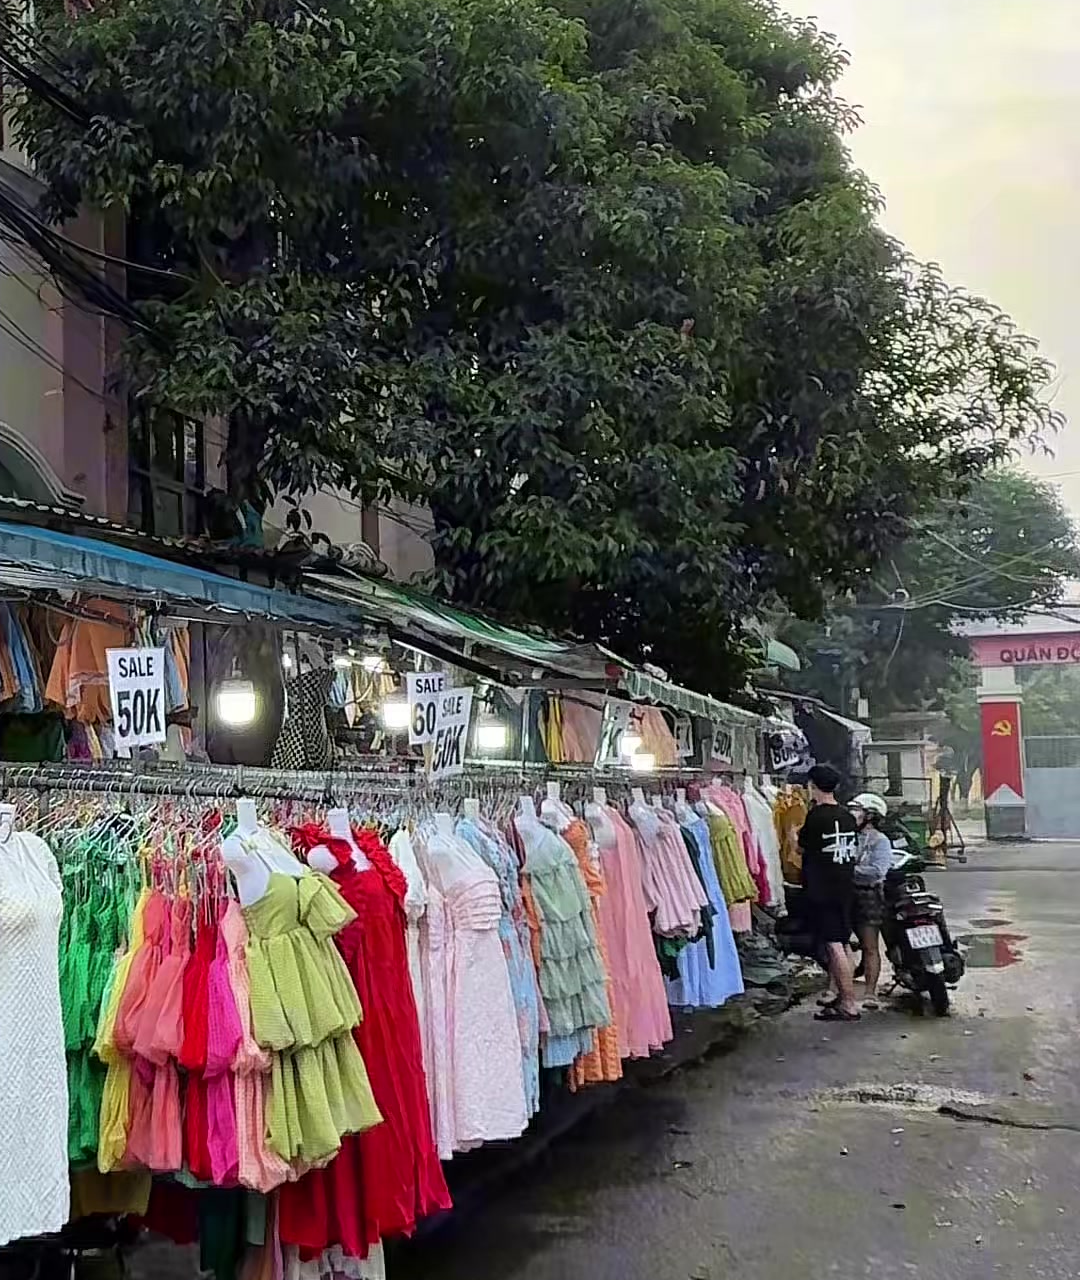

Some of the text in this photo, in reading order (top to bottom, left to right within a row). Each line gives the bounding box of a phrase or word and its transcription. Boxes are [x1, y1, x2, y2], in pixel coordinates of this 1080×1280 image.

[118, 656, 154, 679] SALE
[415, 677, 445, 694] SALE
[117, 687, 162, 738] 50K
[432, 723, 466, 772] 50K
